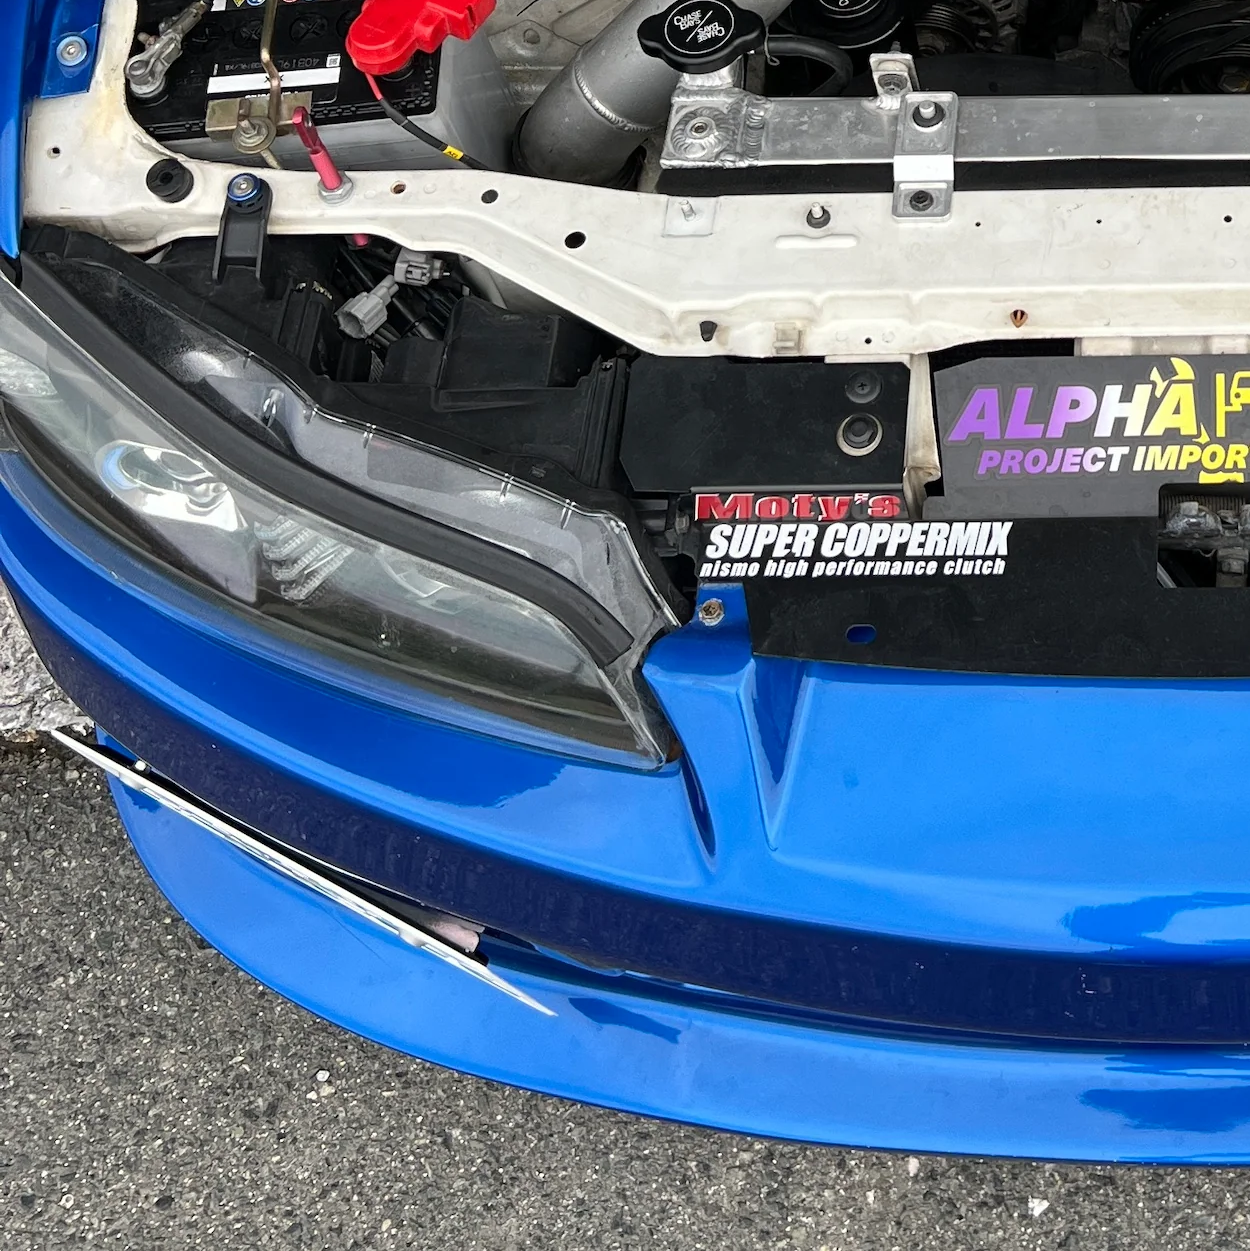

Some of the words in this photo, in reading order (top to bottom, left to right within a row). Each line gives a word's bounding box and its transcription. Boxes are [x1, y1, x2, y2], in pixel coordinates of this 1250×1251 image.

[948, 382, 1199, 442] ALPHA
[977, 446, 1130, 475] PROJECT
[694, 492, 902, 522] Moty's
[706, 522, 819, 558] SUPER
[820, 521, 1014, 558] COPPERMIX
[700, 559, 760, 578] nismo
[764, 558, 807, 579] high
[812, 557, 937, 578] performance
[943, 557, 1006, 576] clutch
